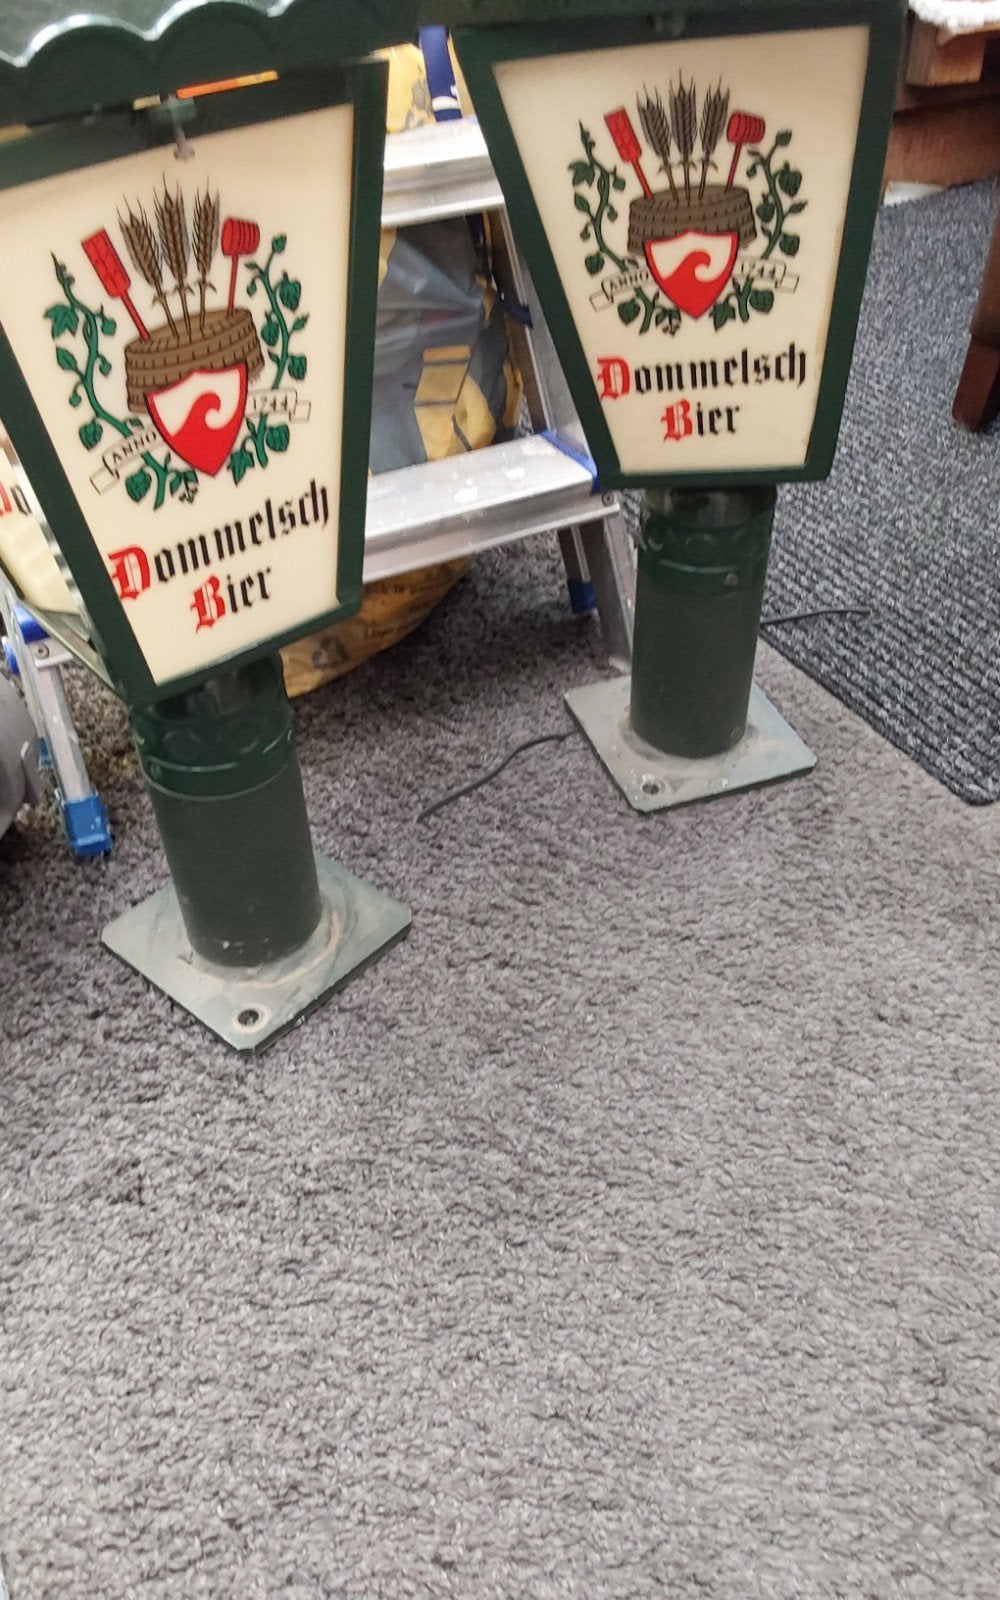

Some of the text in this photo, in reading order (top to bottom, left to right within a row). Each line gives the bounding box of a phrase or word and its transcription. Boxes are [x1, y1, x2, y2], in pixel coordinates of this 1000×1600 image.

[609, 271, 650, 291] ANNO
[597, 341, 806, 401] Dommelsch
[660, 397, 741, 443] Bier
[111, 431, 157, 464] ANNO
[107, 477, 329, 601] Dommelsch
[190, 566, 272, 635] Bier
